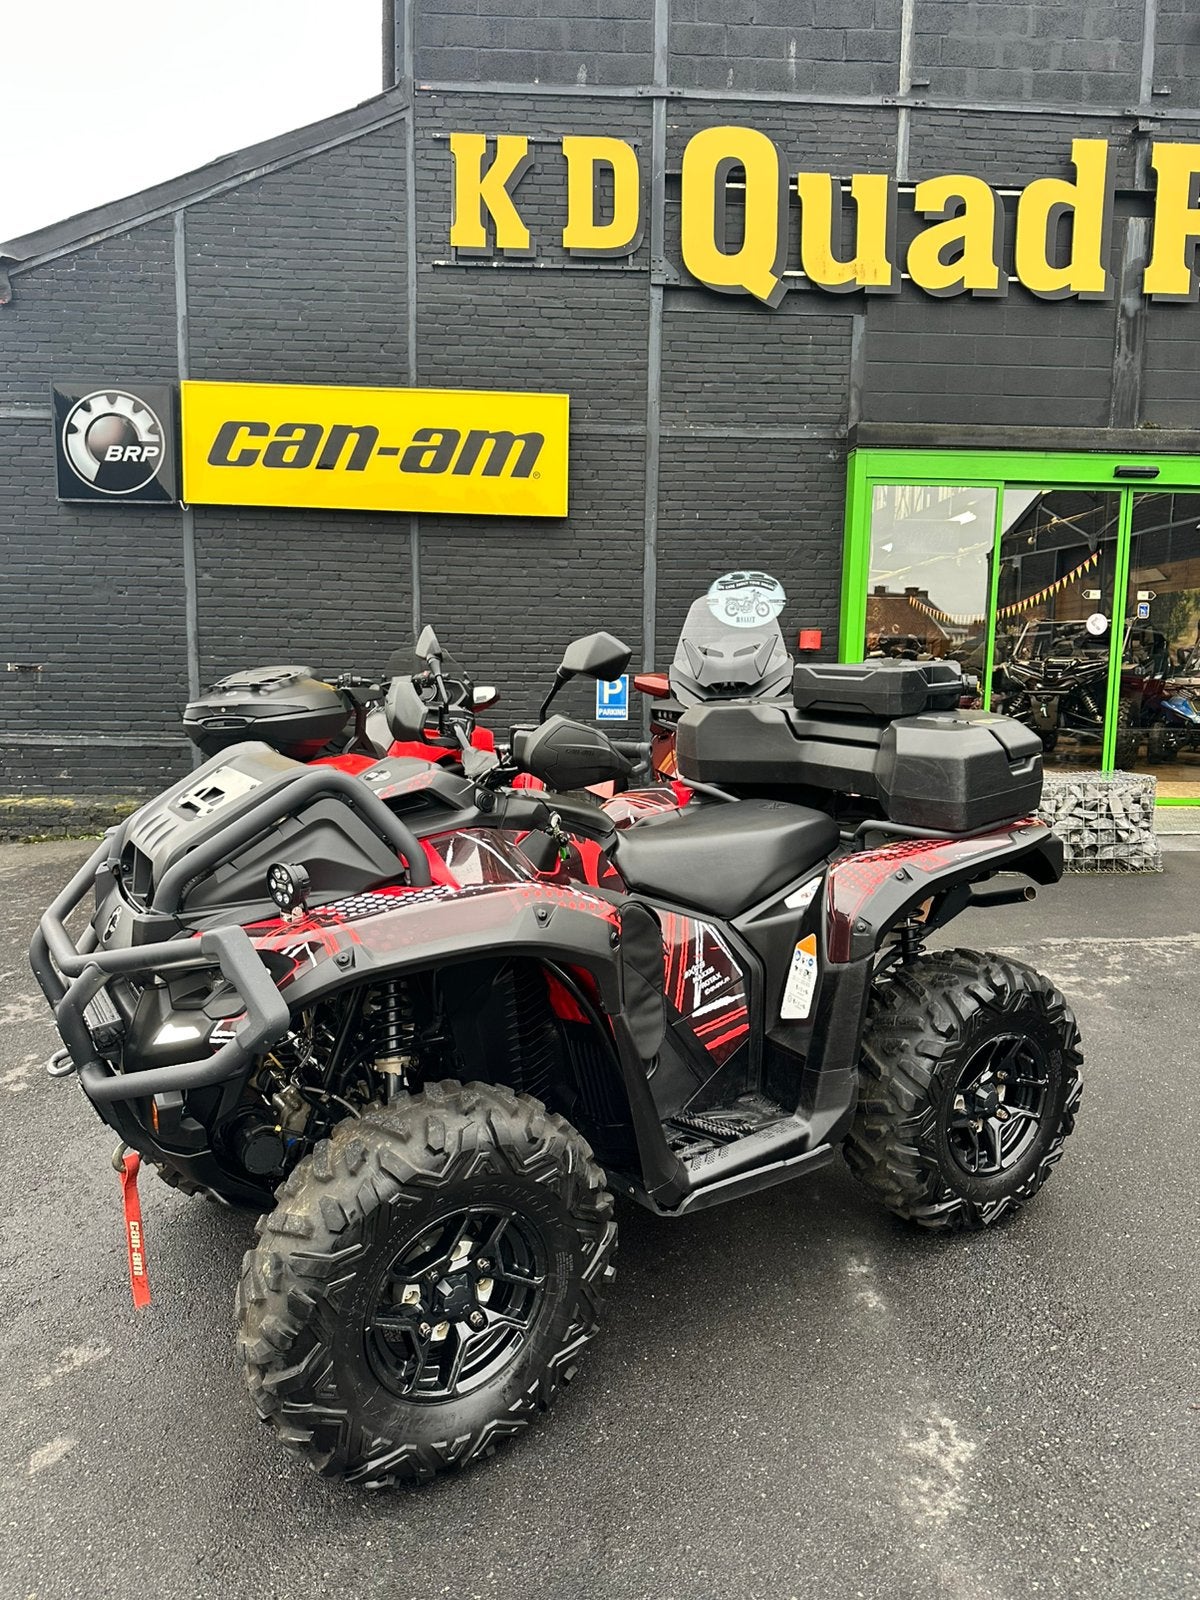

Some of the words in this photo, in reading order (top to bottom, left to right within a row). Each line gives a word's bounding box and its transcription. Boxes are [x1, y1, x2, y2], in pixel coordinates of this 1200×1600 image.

[681, 125, 1109, 301] Quad
[104, 445, 160, 462] BRP
[207, 420, 545, 478] can-am
[603, 680, 623, 704] P
[598, 708, 626, 716] PARKING
[699, 972, 723, 989] ROTAX
[129, 1221, 144, 1276] can-am
